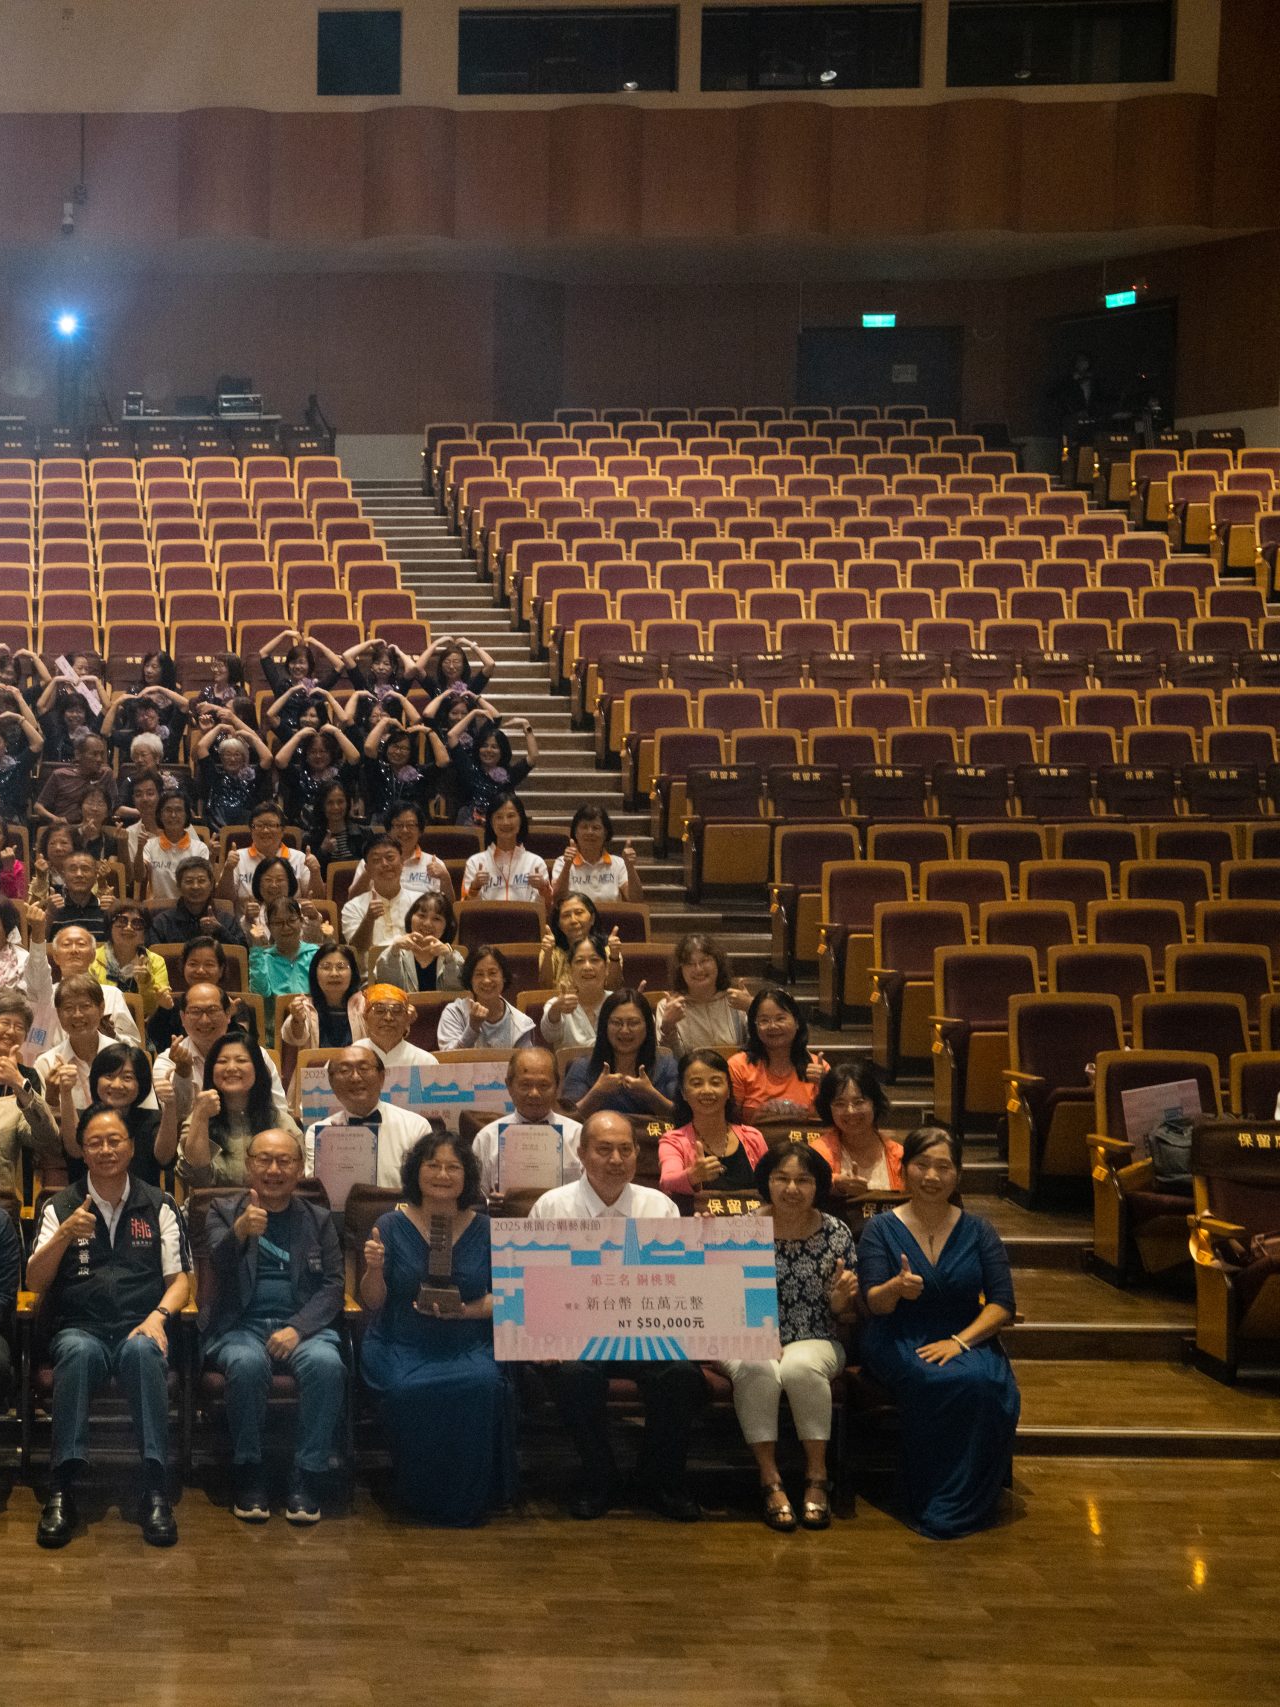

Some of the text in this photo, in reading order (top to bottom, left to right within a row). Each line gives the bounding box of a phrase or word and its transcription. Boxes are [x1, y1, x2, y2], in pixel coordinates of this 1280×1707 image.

[303, 1069, 326, 1081] 2025
[494, 1220, 520, 1232] 2025
[590, 1273, 630, 1287] 第三名
[586, 1295, 632, 1311] 新台幣
[641, 1295, 704, 1311] 伍萬元整
[637, 1316, 705, 1330] $50,000元
